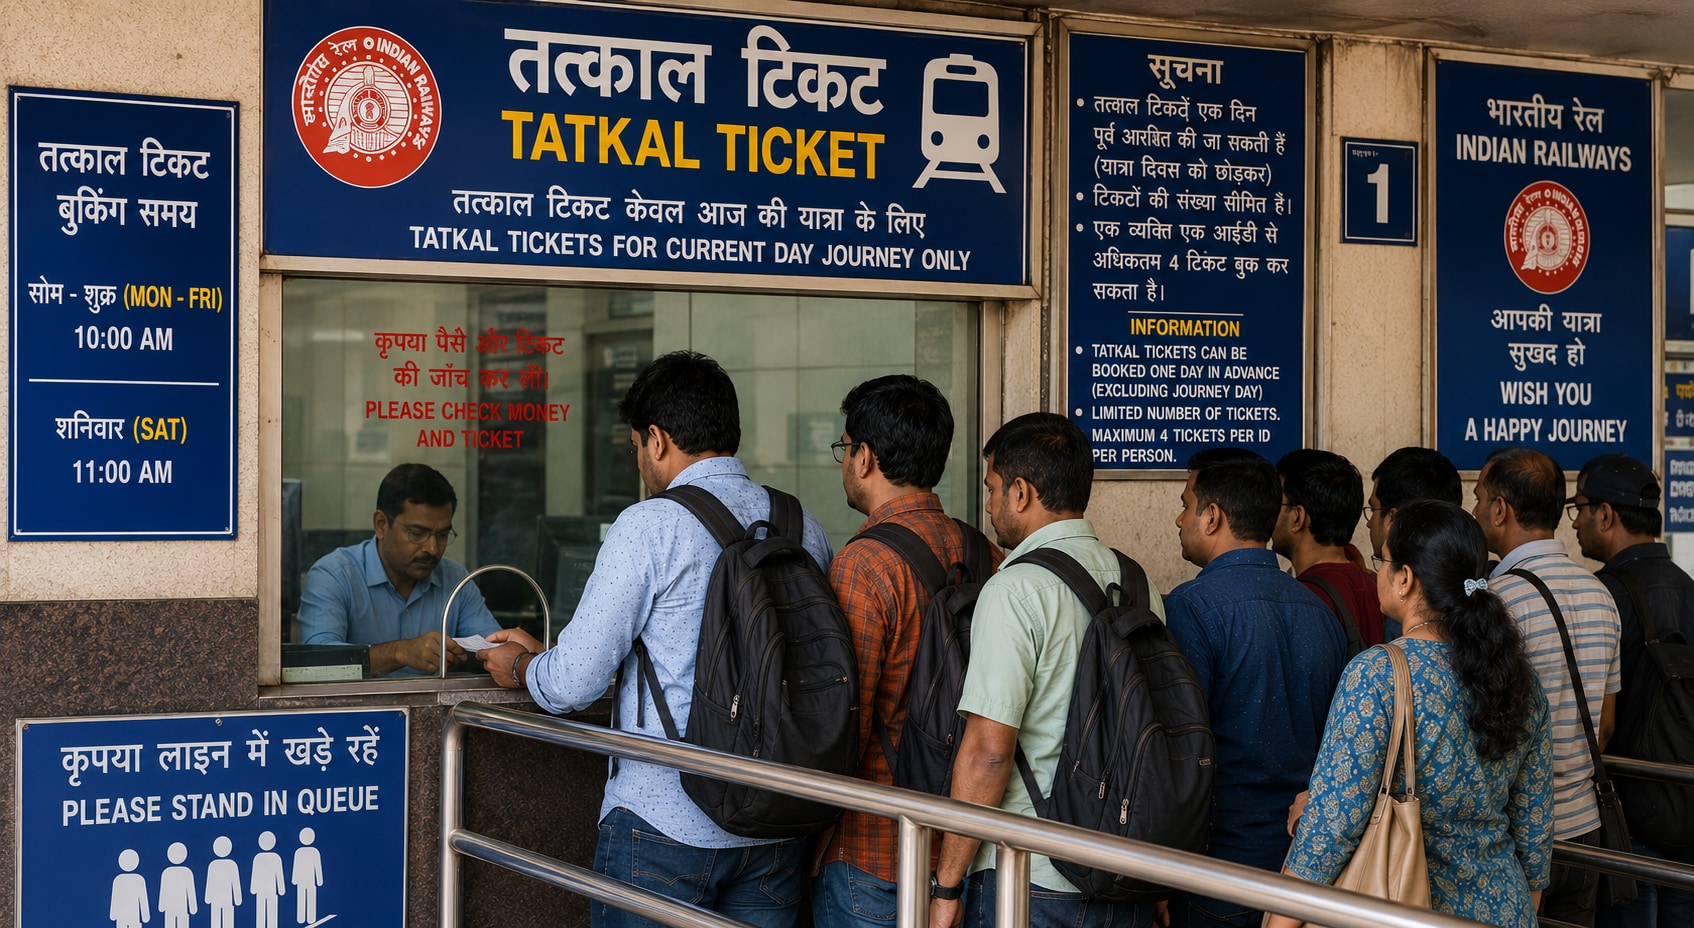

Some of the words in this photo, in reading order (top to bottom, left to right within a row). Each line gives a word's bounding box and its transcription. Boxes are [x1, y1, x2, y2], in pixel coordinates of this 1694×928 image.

[376, 37, 421, 76] INDIAN
[504, 28, 712, 103] तत्काल
[741, 25, 886, 115] टिकट
[1148, 55, 1223, 89] सूचना
[1197, 103, 1223, 122] एक
[1230, 99, 1256, 122] दिन
[1487, 94, 1564, 129] भारतीय
[1572, 97, 1604, 133] रेल
[502, 110, 700, 168] TATKAL
[717, 124, 885, 179] TICKET
[1094, 122, 1115, 149] पूर्व
[1177, 127, 1197, 148] की
[1203, 134, 1221, 150] जा
[1228, 131, 1269, 152] सकती
[1275, 132, 1286, 155] हैं
[1457, 134, 1526, 164] INDIAN
[1534, 140, 1631, 171] RAILWAYS
[38, 142, 128, 175] तत्काल
[140, 137, 210, 179] टिकट
[1095, 155, 1134, 178] (यात्रा
[1141, 155, 1181, 178] दिवस
[1187, 158, 1208, 179] को
[1215, 159, 1271, 186] छोड़कर)
[1093, 183, 1141, 207] टिकटों
[1148, 187, 1169, 208] की
[1176, 189, 1216, 210] संख्या
[1223, 191, 1267, 213] सीमित
[1368, 164, 1388, 223] 1
[57, 186, 127, 235] बुकिंग
[138, 199, 198, 228] समय
[452, 190, 534, 216] तत्काल
[547, 185, 611, 219] टिकट
[625, 189, 685, 223] केवल
[698, 203, 747, 226] आज
[757, 197, 787, 228] की
[798, 207, 844, 231] यात्रा
[855, 201, 876, 231] के
[886, 203, 926, 238] लिए
[1093, 221, 1120, 240] एक
[1128, 217, 1172, 239] व्यक्ति
[1179, 225, 1205, 243] एक
[1214, 221, 1257, 245] आईडी
[1265, 222, 1278, 243] से
[410, 226, 498, 251] TATKAL
[508, 231, 602, 256] TICKETS
[614, 236, 657, 258] FOR
[667, 238, 766, 262] CURRENT
[775, 242, 814, 264] DAY
[822, 245, 914, 268] JOURNEY
[922, 249, 970, 270] ONLY
[1093, 247, 1161, 270] अधिकतम
[1169, 255, 1179, 270] 4
[1234, 257, 1259, 279] बुक
[1266, 258, 1289, 273] कर
[28, 275, 64, 304] सोम
[84, 285, 117, 313] शुक्र
[124, 284, 171, 310] (MON
[190, 287, 222, 312] FRI)
[1093, 283, 1138, 300] सकता
[1131, 319, 1239, 336] INFORMATION
[1491, 304, 1553, 331] आपकी
[1562, 312, 1602, 332] यात्रा
[75, 326, 132, 349] 10:00
[140, 327, 172, 350] AM
[374, 332, 427, 359] कृपया
[475, 328, 509, 354] और
[515, 328, 565, 355] टिकट
[1092, 344, 1139, 358] TATKAL
[1144, 345, 1196, 359] TICKETS
[1201, 346, 1226, 359] CAN
[1232, 347, 1247, 360] BE
[1508, 343, 1558, 371] सुखद
[1566, 337, 1585, 367] हो
[393, 360, 420, 386] की
[479, 370, 510, 388] कर
[1093, 364, 1145, 377] BOOKED
[1151, 365, 1176, 377] ONE
[1181, 365, 1204, 378] DAY
[1209, 366, 1219, 378] IN
[1224, 366, 1279, 379] ADVANCE
[1092, 383, 1168, 399] (EXCLUDING
[1173, 385, 1230, 398] JOURNEY
[1235, 385, 1262, 400] DAY)
[1501, 382, 1547, 404] WISH
[1555, 383, 1591, 405] YOU
[366, 401, 434, 419] PLEASE
[442, 402, 501, 420] CHECK
[508, 403, 570, 421] MONEY
[1093, 406, 1142, 419] LIMITED
[1148, 407, 1200, 420] NUMBER
[1206, 407, 1221, 420] OF
[1226, 407, 1280, 420] TICKETS.
[55, 410, 125, 439] शनिवार
[134, 416, 186, 444] (SAT)
[417, 430, 455, 447] AND
[461, 430, 524, 448] TICKET
[1093, 429, 1154, 441] MAXIMUM
[1160, 429, 1168, 441] 4
[1173, 429, 1225, 442] TICKETS
[1231, 429, 1253, 442] PER
[1259, 429, 1270, 442] ID
[1465, 418, 1478, 440] A
[1484, 418, 1542, 441] HAPPY
[1548, 419, 1626, 442] JOURNEY
[1093, 449, 1116, 462] PER
[1122, 449, 1176, 462] PERSON.
[73, 460, 130, 483] 11:00
[139, 461, 171, 483] AM
[61, 745, 143, 786] कृपया
[157, 741, 232, 775] लाइन
[246, 729, 269, 766] में
[283, 727, 334, 771] खड़े
[346, 725, 380, 765] रहें
[63, 796, 161, 826] PLEASE
[172, 792, 253, 820] STAND
[264, 790, 287, 815] IN
[298, 786, 378, 815] QUEUE
